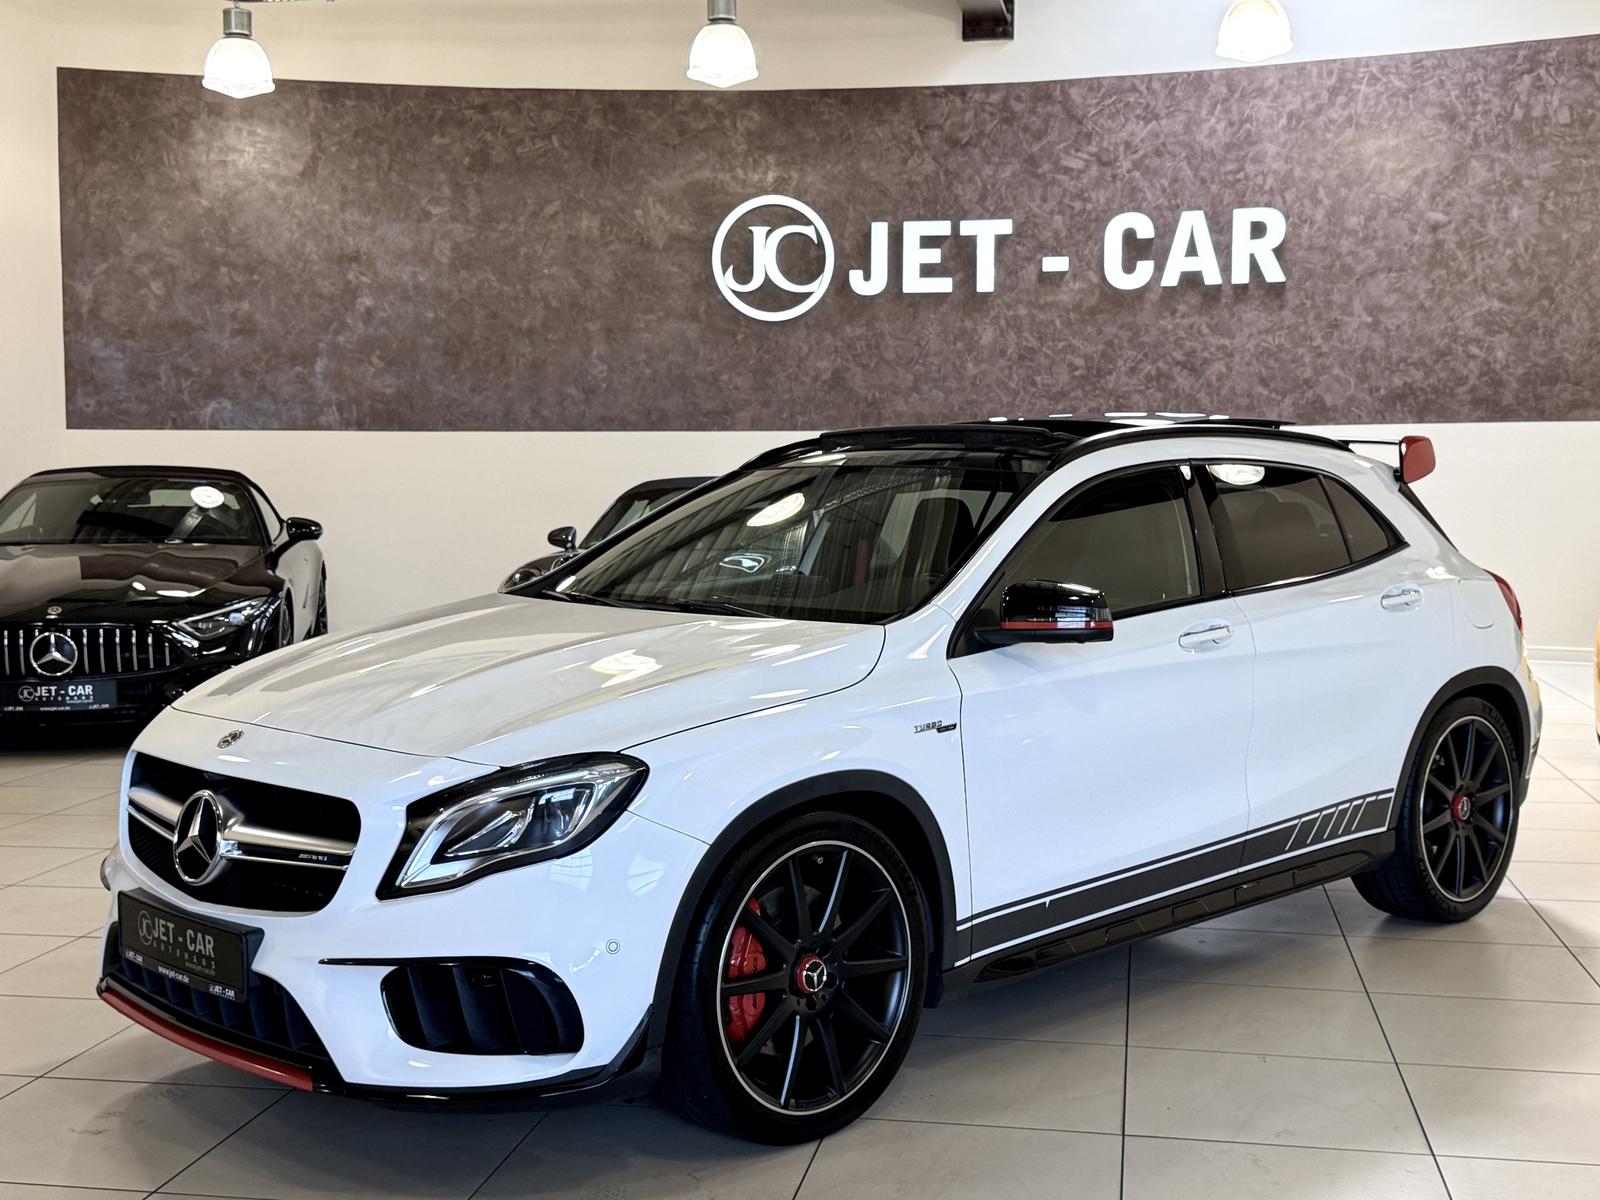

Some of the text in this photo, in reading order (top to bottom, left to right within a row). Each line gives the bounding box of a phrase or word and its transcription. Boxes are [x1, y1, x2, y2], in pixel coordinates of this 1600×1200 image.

[849, 219, 1013, 296] JET
[1042, 255, 1069, 272] -
[1103, 207, 1287, 291] CAR
[35, 686, 57, 697] JET
[68, 685, 93, 696] CAR
[153, 917, 175, 943] JET
[186, 929, 215, 958] CAR
